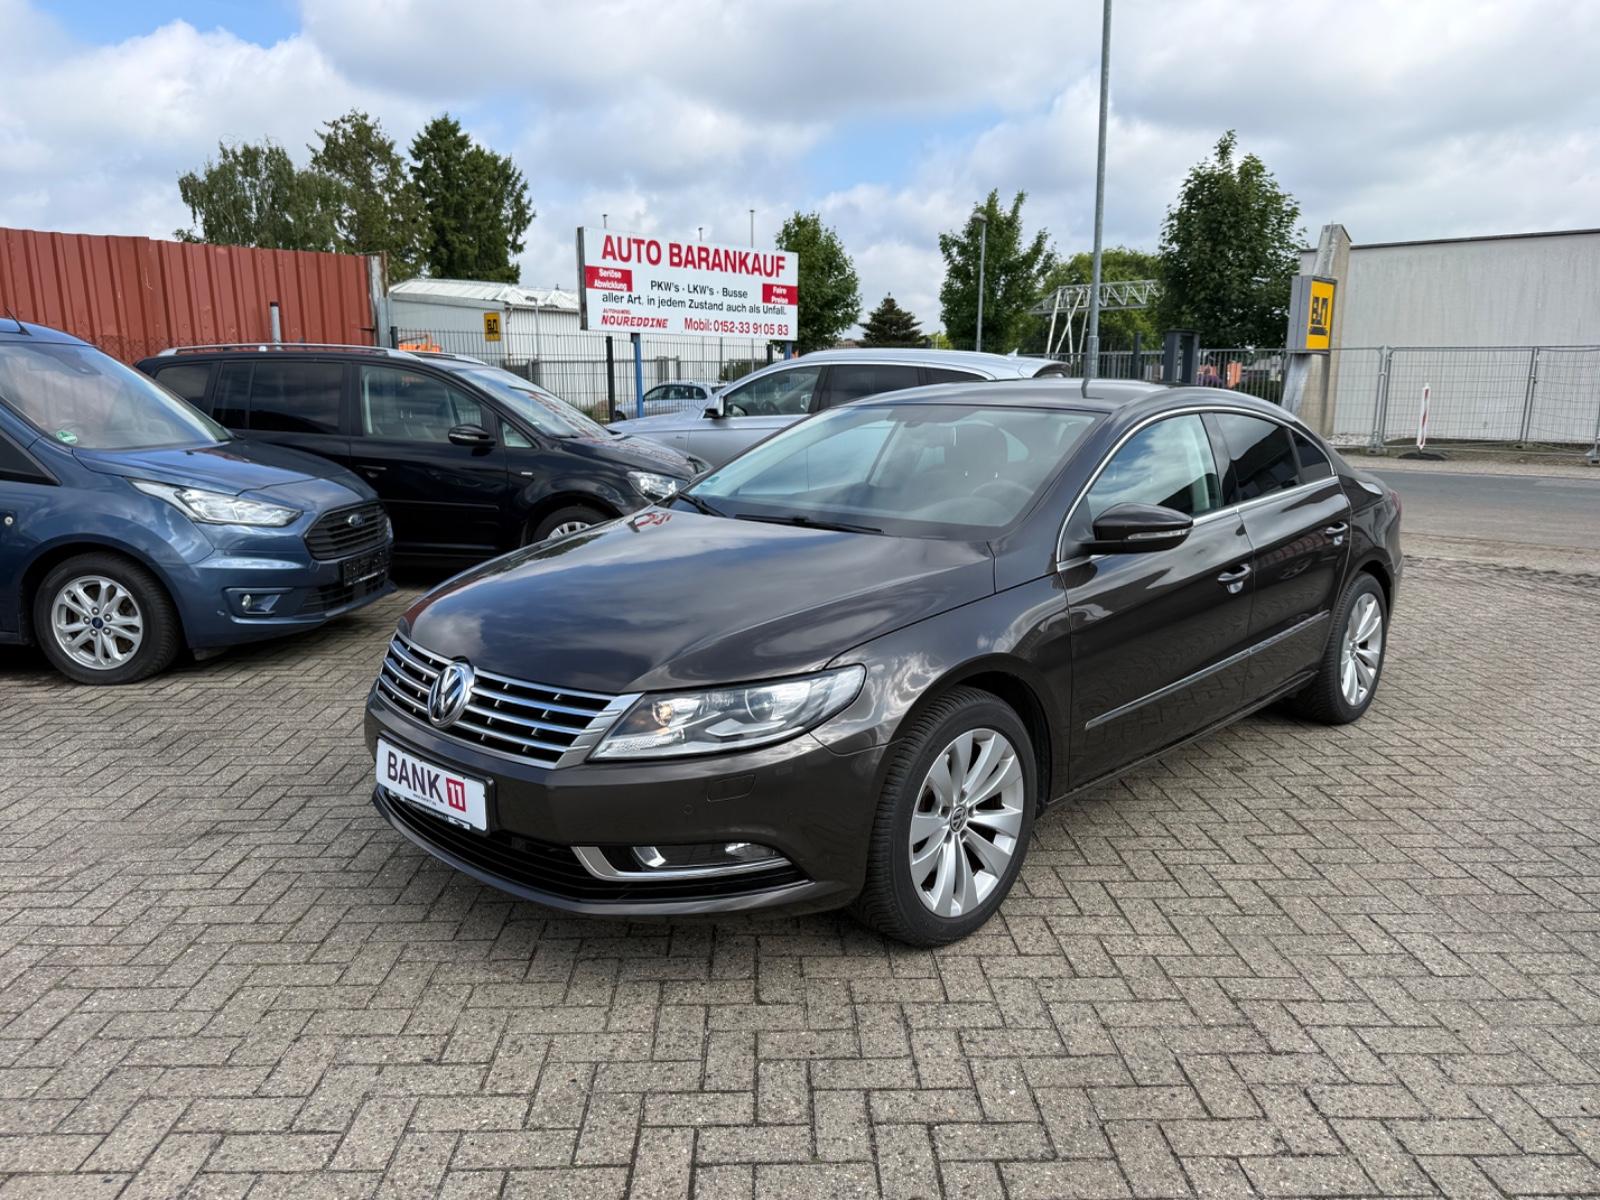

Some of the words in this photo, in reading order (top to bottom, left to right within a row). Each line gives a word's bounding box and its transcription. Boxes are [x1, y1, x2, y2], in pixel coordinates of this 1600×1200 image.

[602, 235, 662, 266] AUTO
[669, 242, 786, 278] BARANKAUF
[722, 288, 748, 299] Busse
[773, 286, 787, 295] Faire
[602, 293, 624, 304] aller
[647, 296, 655, 306] in
[657, 296, 686, 309] jedem
[688, 299, 724, 312] Zustand
[726, 302, 747, 313] auch
[749, 303, 761, 314] als
[601, 314, 669, 329] NOUREDDINE
[684, 317, 712, 332] Mobil:
[387, 750, 445, 804] BANK
[447, 782, 465, 811] 11
